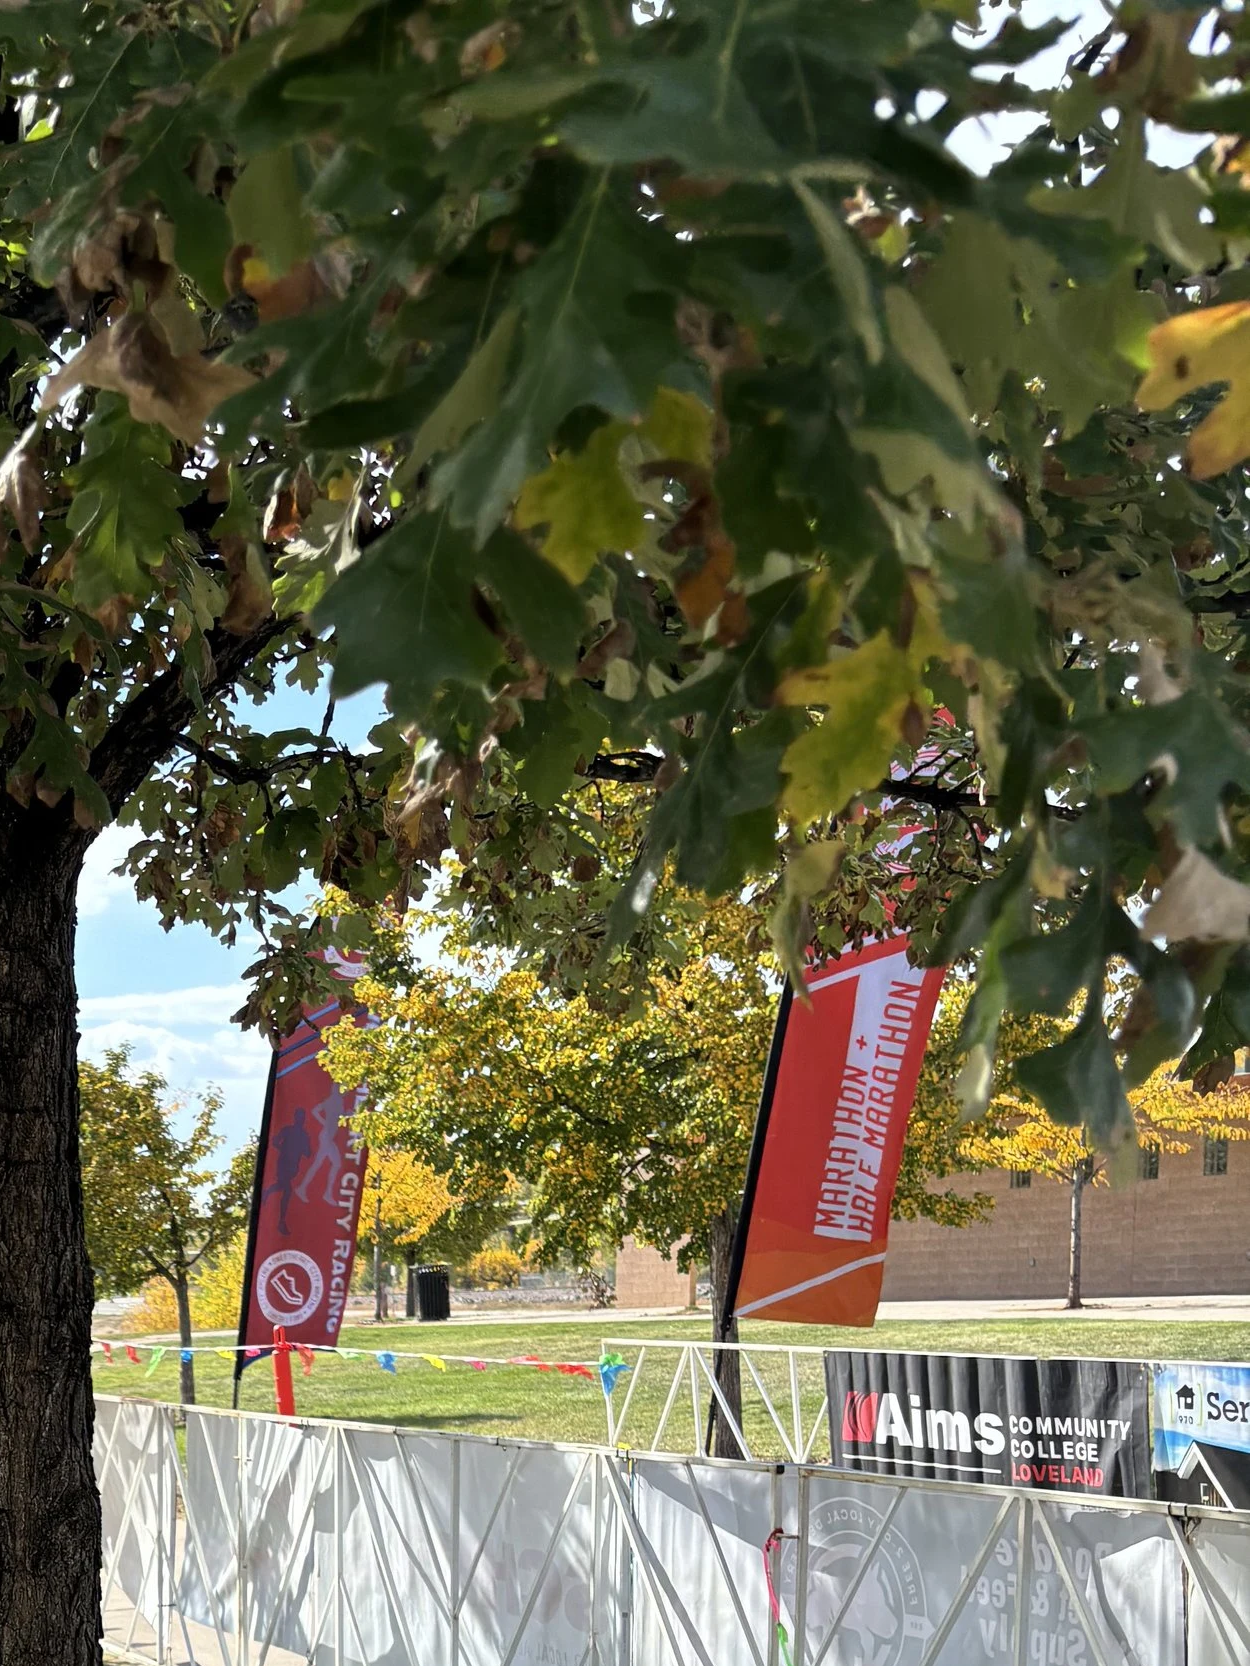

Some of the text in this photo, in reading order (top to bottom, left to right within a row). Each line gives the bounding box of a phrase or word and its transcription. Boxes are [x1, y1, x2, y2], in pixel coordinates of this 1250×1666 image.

[844, 980, 922, 1235] HALF MARATHON
[336, 1173, 360, 1232] CITY
[325, 1239, 352, 1334] RACING
[875, 1392, 1006, 1457] Aims
[1009, 1414, 1131, 1441] COMMUNITY
[1178, 1415, 1194, 1425] 970
[1010, 1438, 1099, 1463] COLLEGE
[1011, 1461, 1104, 1488] LOVELAND
